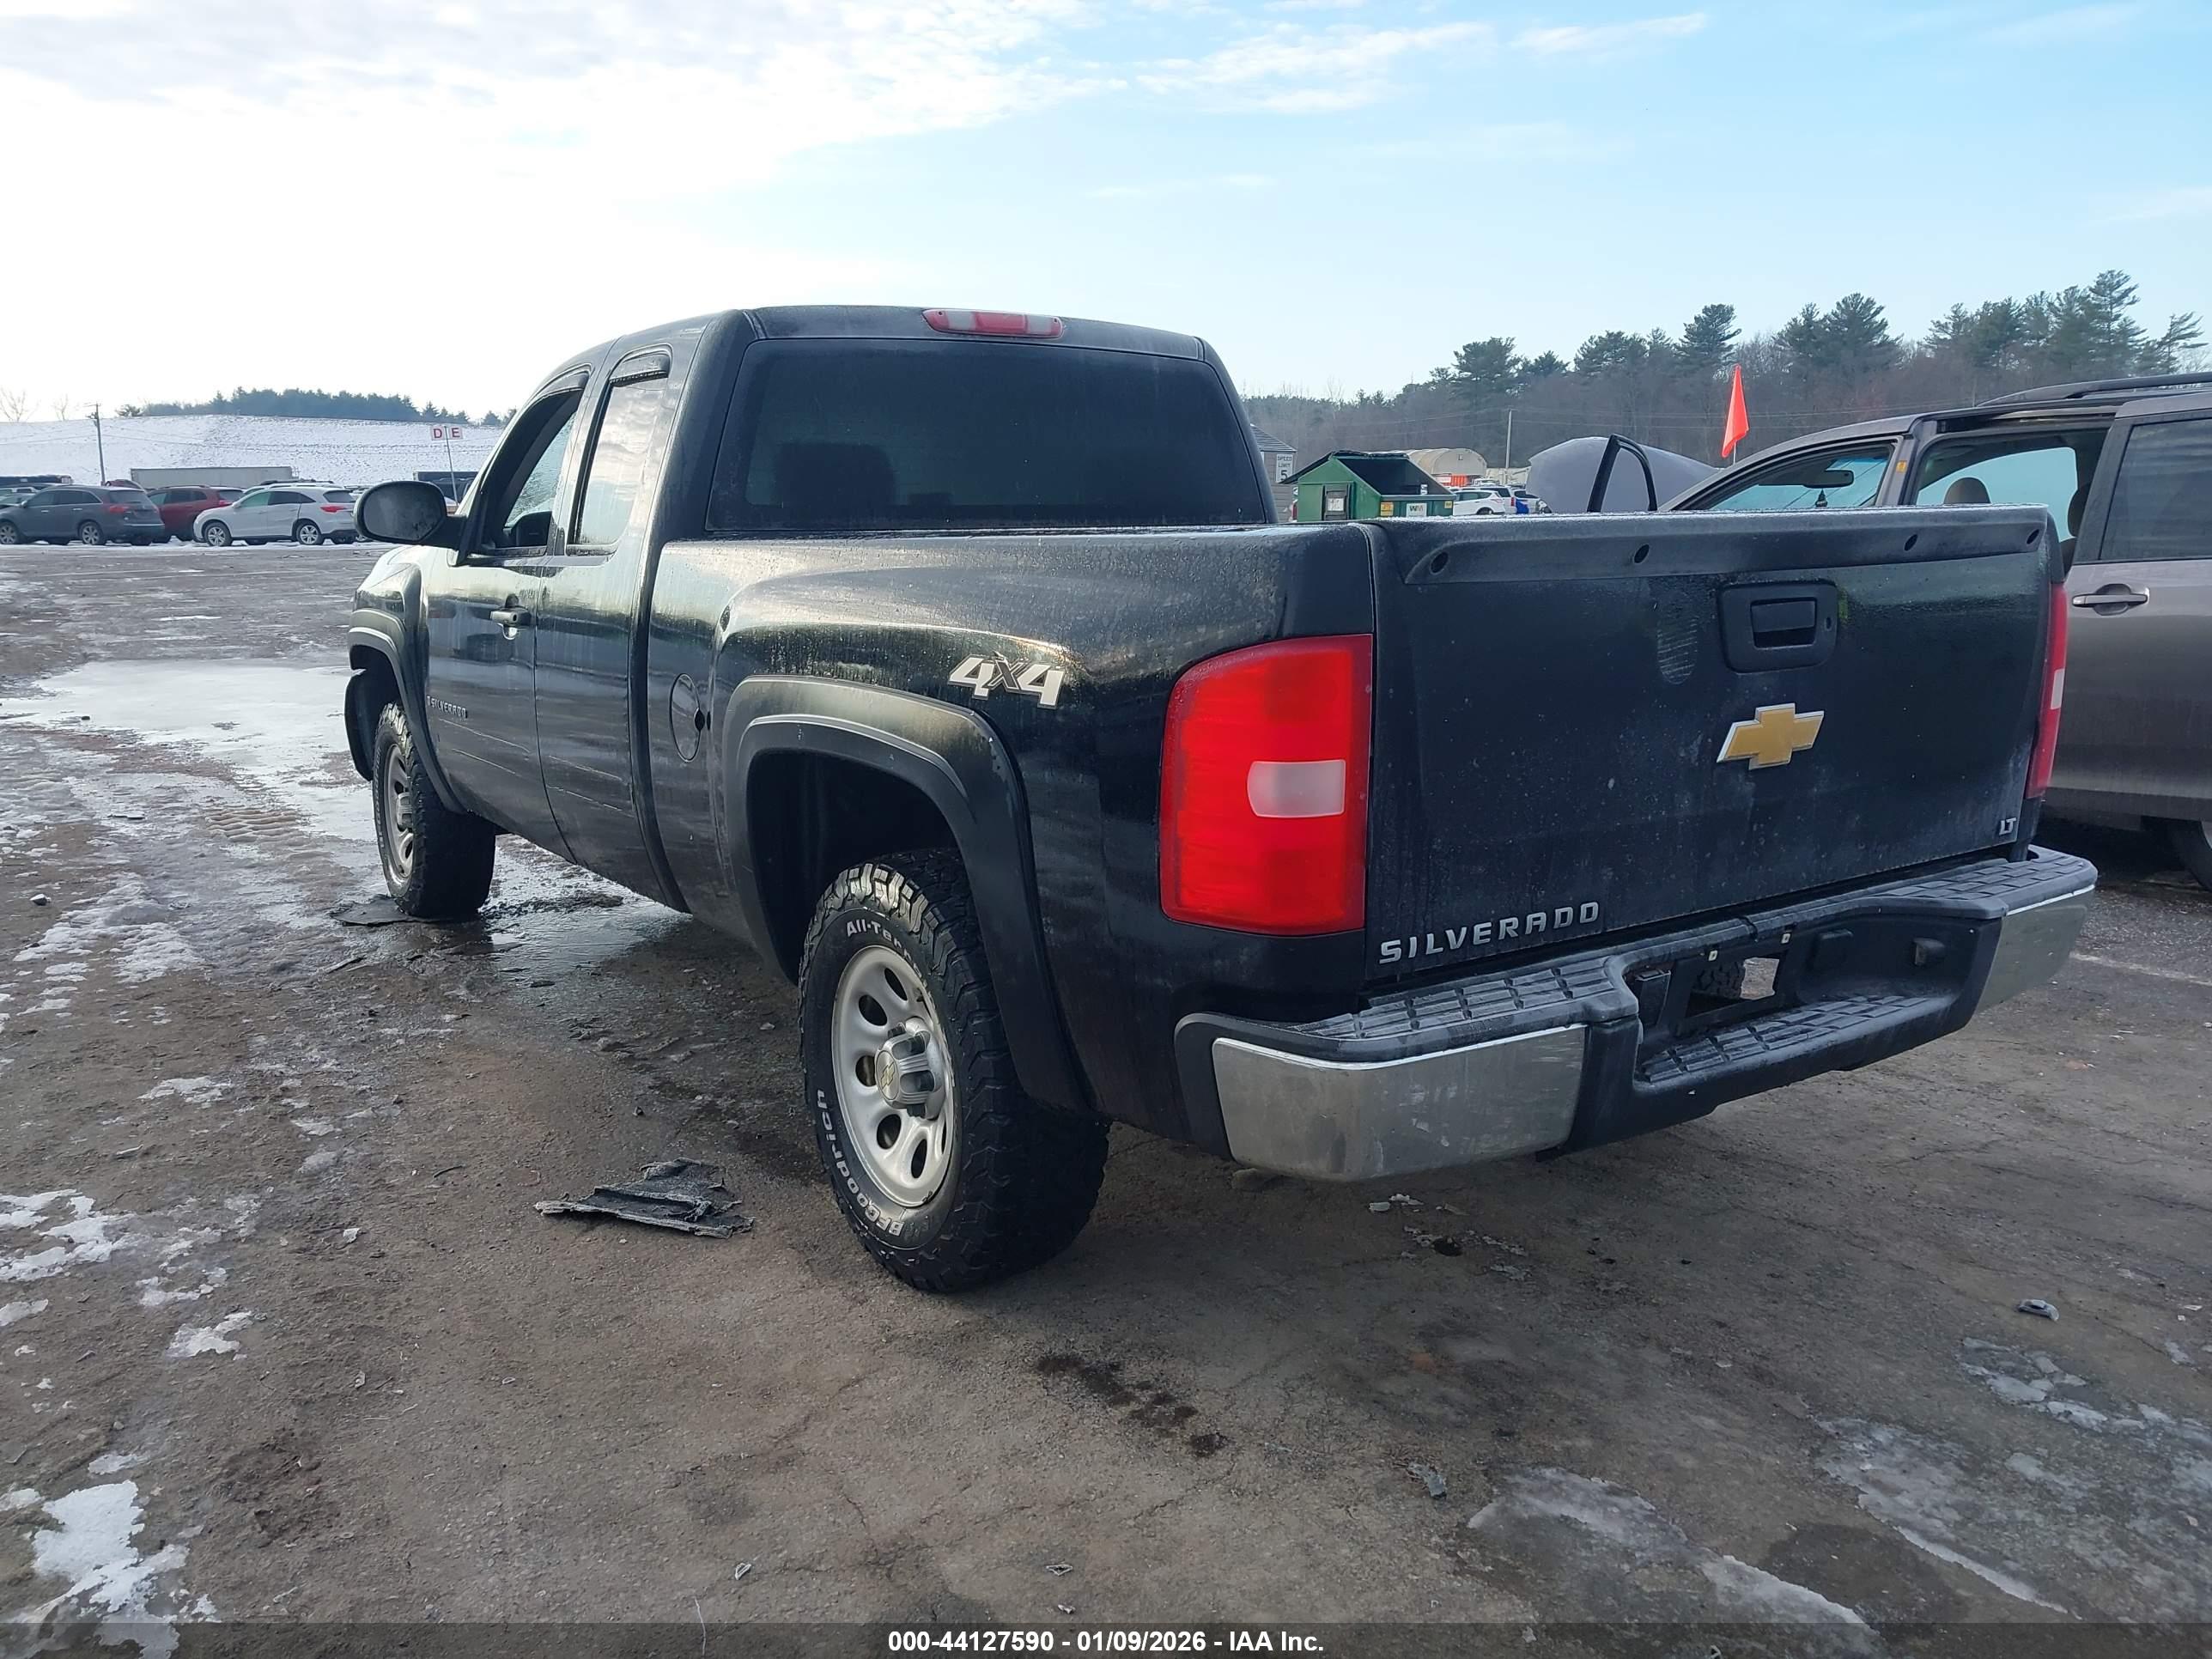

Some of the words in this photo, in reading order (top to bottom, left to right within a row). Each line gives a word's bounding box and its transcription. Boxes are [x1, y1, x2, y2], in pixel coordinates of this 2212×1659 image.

[434, 428, 443, 439] D
[451, 427, 461, 438] E
[1280, 470, 1288, 481] 5
[1998, 817, 2017, 836] LT
[1378, 901, 1600, 965] SILVERADO
[817, 1089, 905, 1237] BFGoodrich
